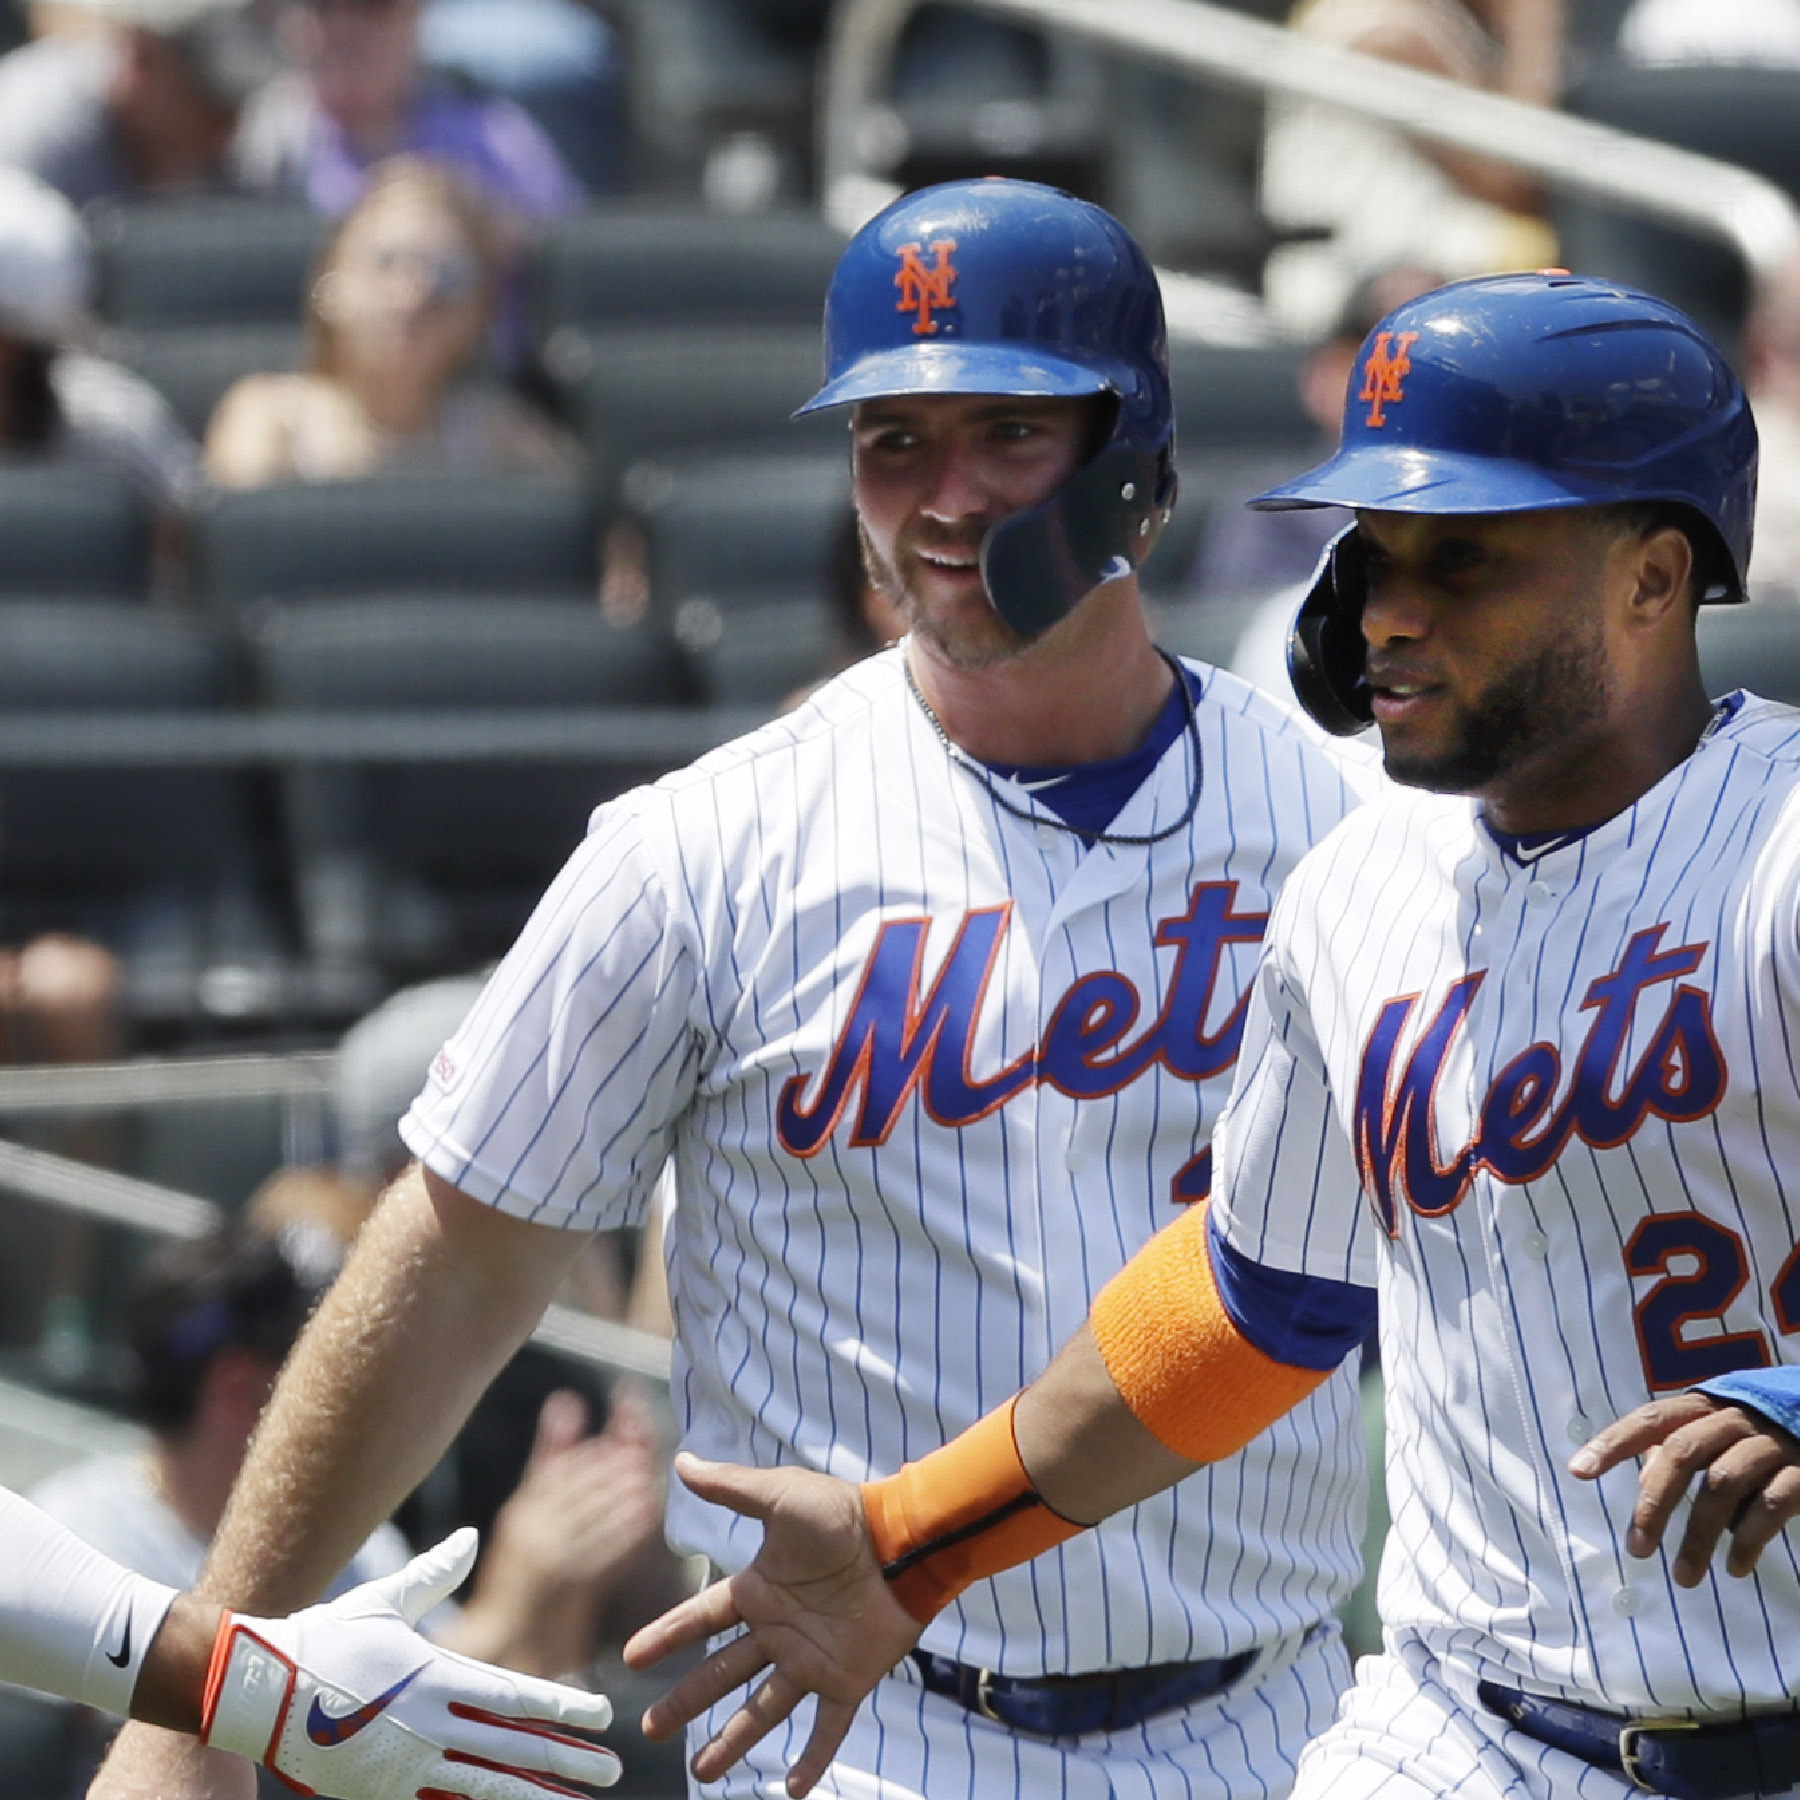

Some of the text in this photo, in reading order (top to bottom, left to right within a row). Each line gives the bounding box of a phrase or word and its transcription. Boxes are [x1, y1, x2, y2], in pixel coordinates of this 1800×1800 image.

[895, 240, 957, 334] NY
[1361, 331, 1419, 427] NY
[777, 880, 1267, 1158] Met
[1355, 922, 1727, 1240] Mets
